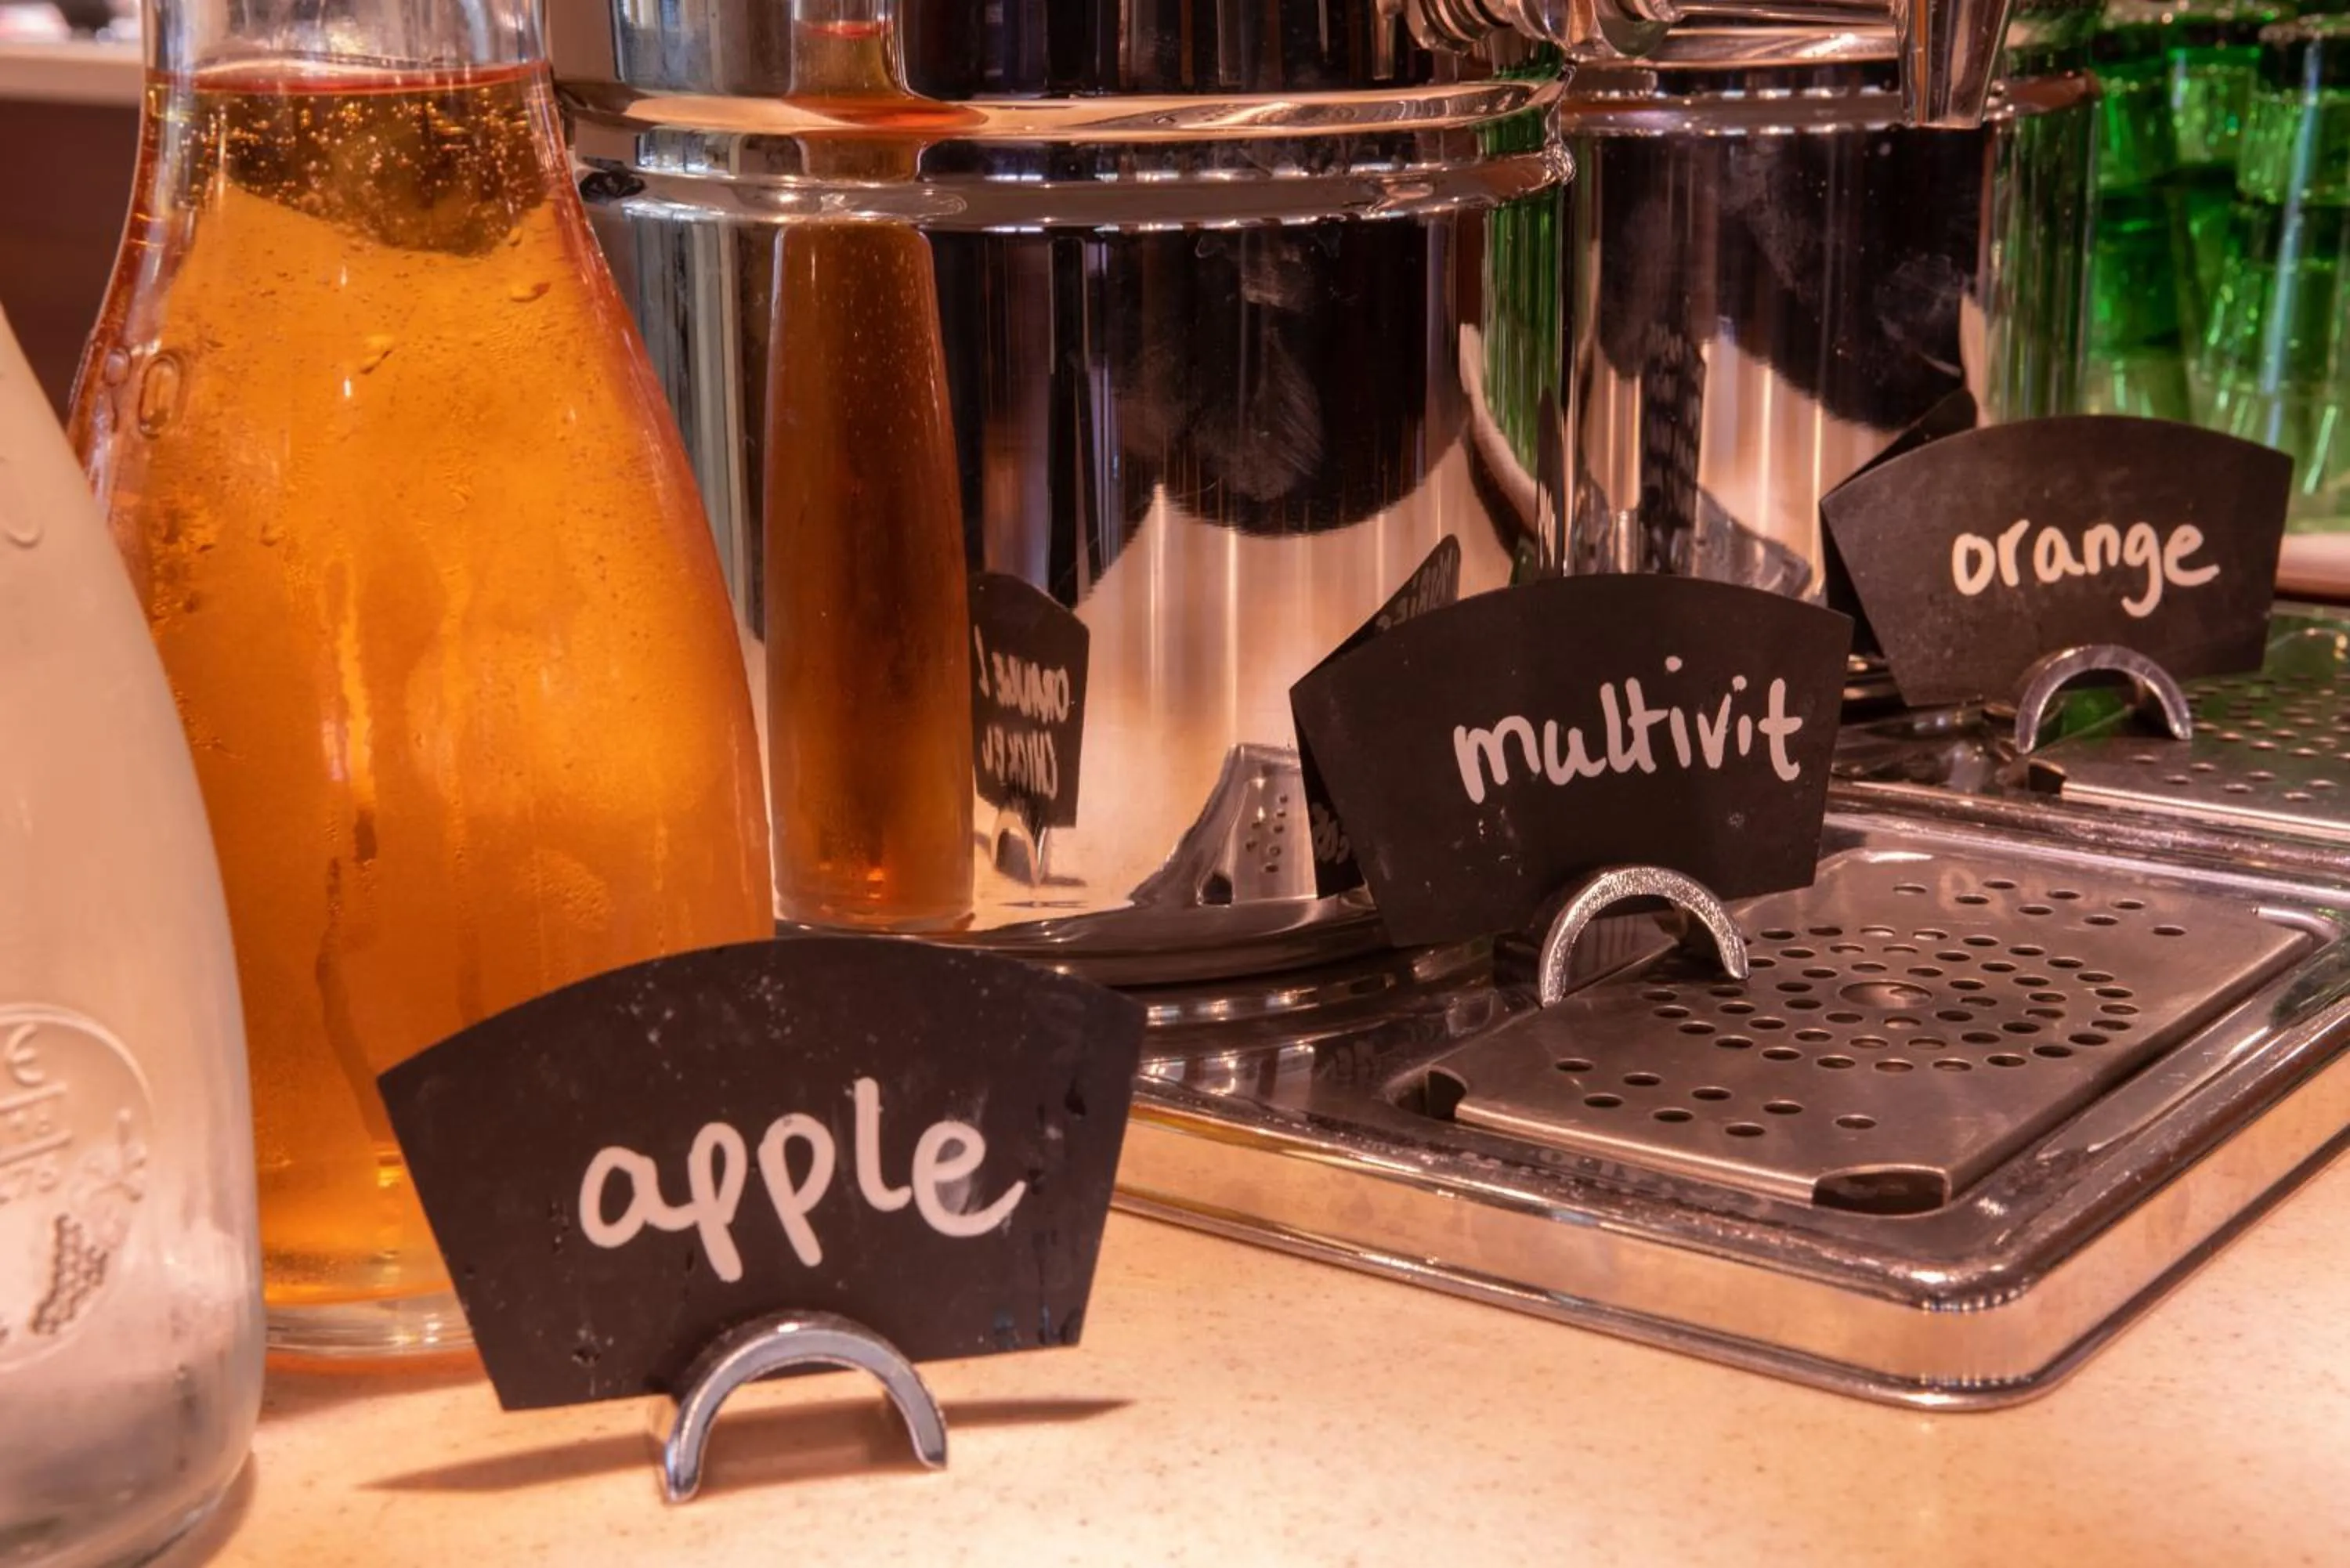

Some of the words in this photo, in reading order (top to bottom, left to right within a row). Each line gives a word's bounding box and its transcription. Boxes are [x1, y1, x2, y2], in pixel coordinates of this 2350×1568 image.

[1952, 519, 2220, 617] orange
[1454, 656, 1802, 804] multivit
[579, 1078, 1026, 1282] apple
